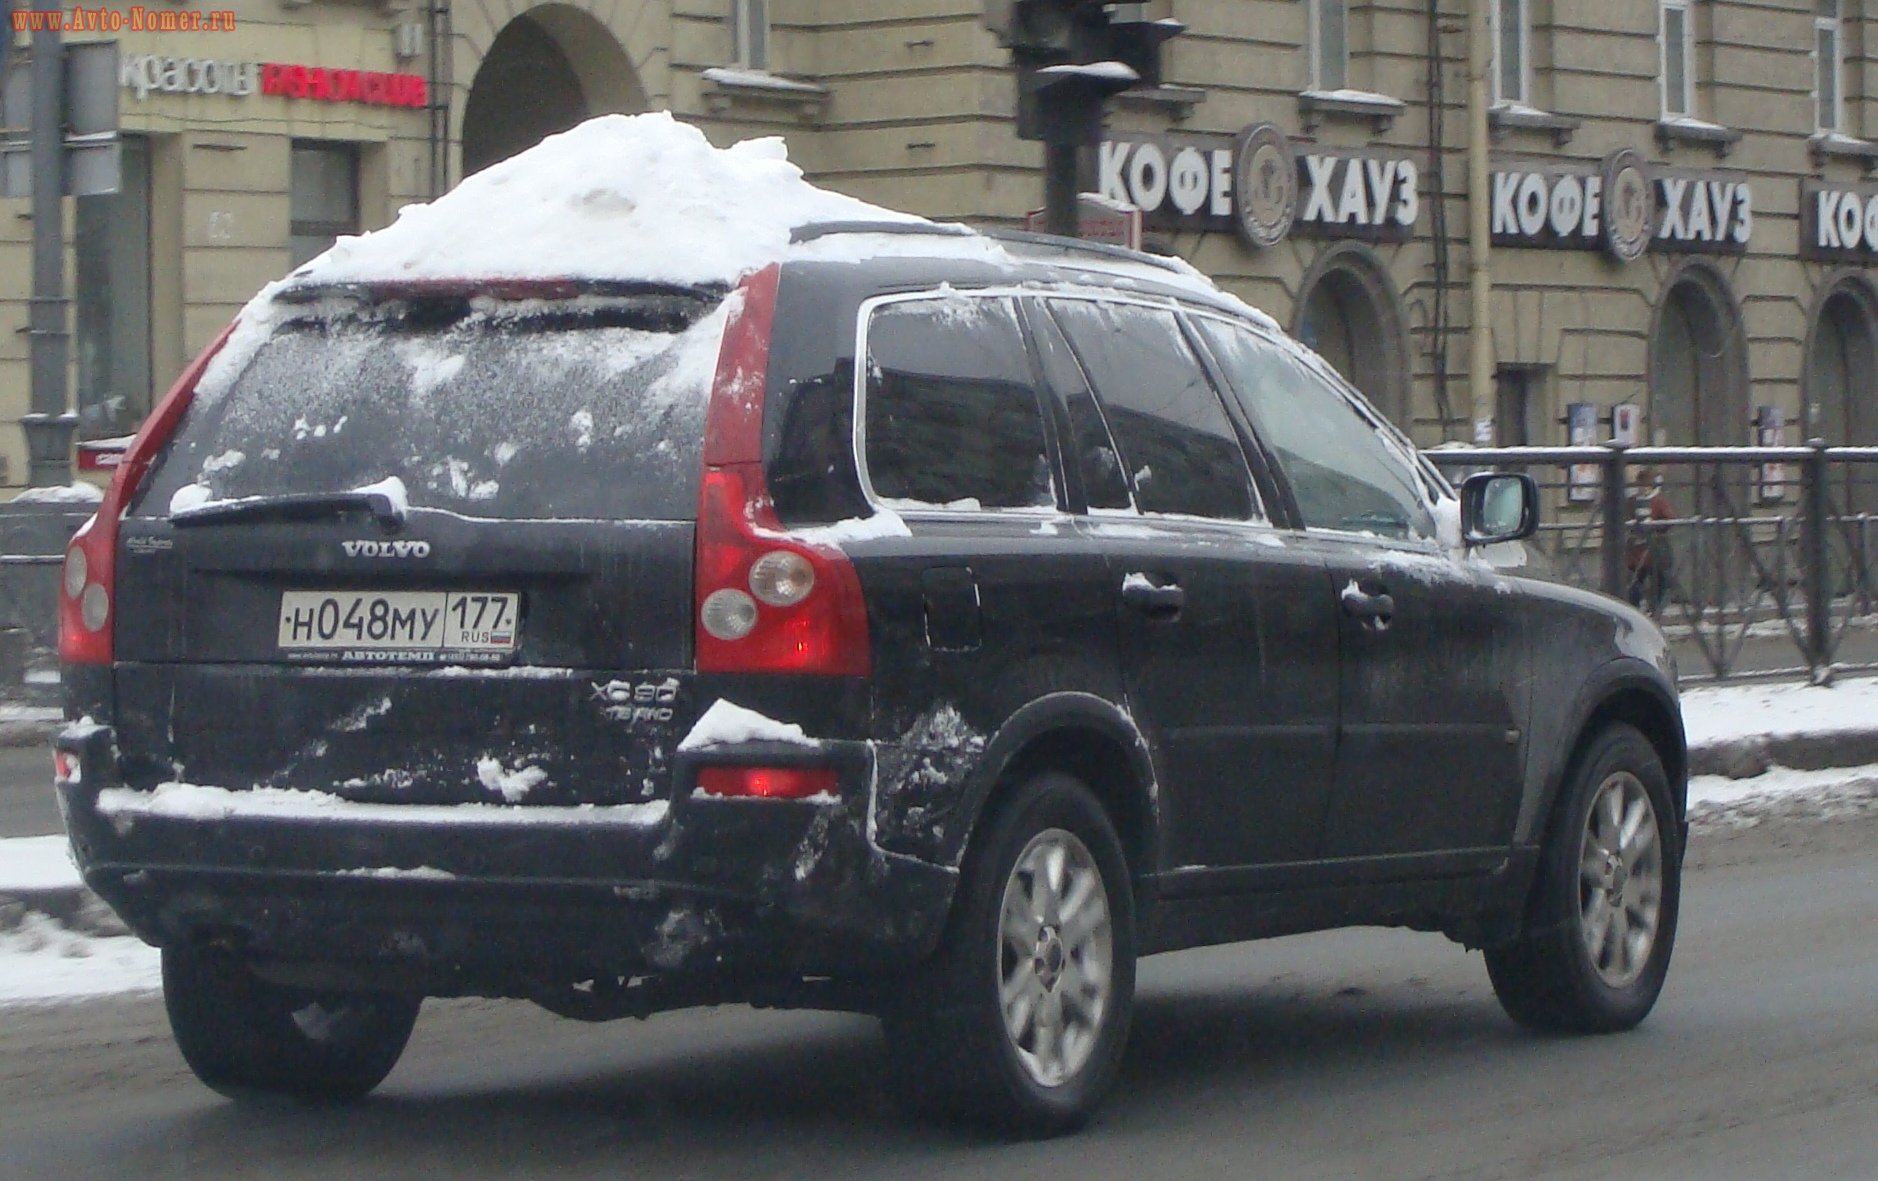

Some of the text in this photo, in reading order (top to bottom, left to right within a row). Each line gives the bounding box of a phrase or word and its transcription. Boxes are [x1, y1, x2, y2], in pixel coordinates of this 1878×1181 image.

[1099, 140, 1233, 216] КОФЕ
[1303, 153, 1418, 236] ХАУЗ
[1492, 171, 1752, 244] КОФЕ ХАУЗ
[341, 540, 431, 558] VOLVO
[452, 597, 508, 630] 177
[461, 631, 489, 643] RUS
[342, 651, 435, 661] АВТОТЕМП
